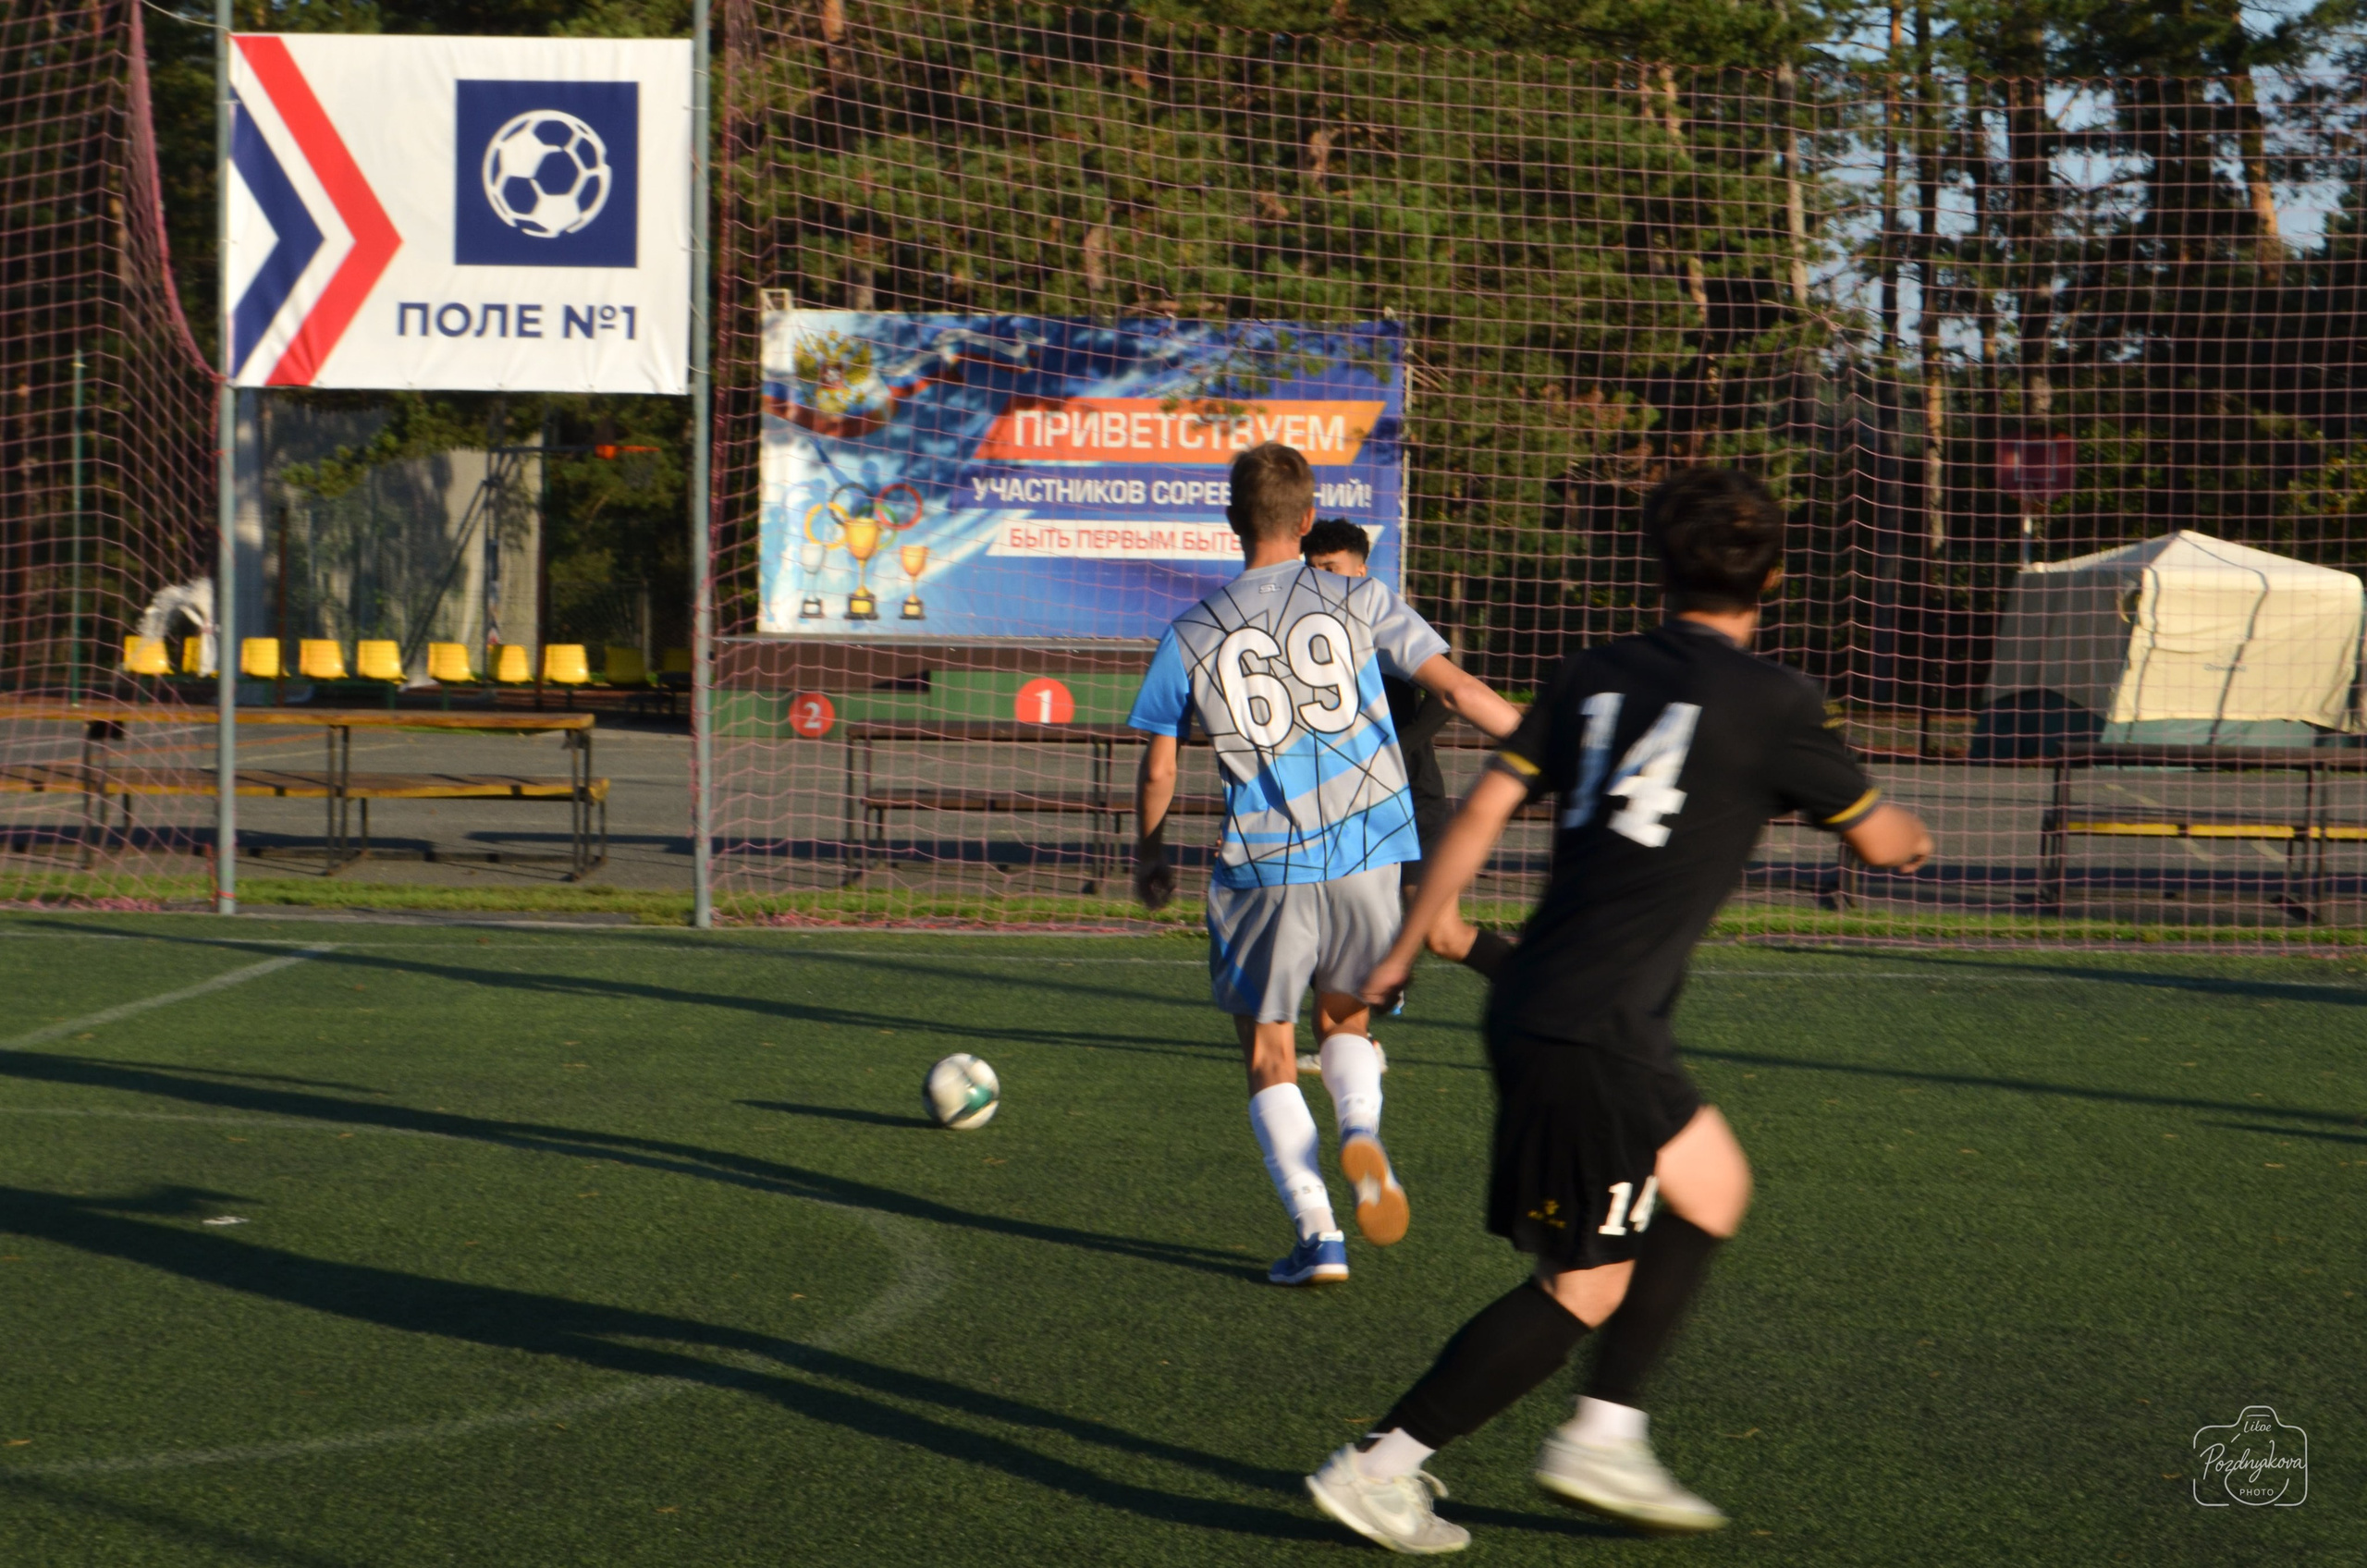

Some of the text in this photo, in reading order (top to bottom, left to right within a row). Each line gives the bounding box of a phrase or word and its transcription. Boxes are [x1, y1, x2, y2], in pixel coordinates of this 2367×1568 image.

[397, 302, 637, 340] ПОЛЕ №1
[1014, 410, 1345, 451] ПРИВЕТСТВУЕМ
[971, 477, 1147, 504] УЧАСТНИКОВ
[1009, 528, 1073, 549] БЫТЬ
[1077, 529, 1176, 550] ПЕРВЫМ
[1216, 611, 1361, 749] 69
[803, 701, 823, 729] 2
[1034, 688, 1053, 724] 1
[1562, 691, 1703, 848] 14
